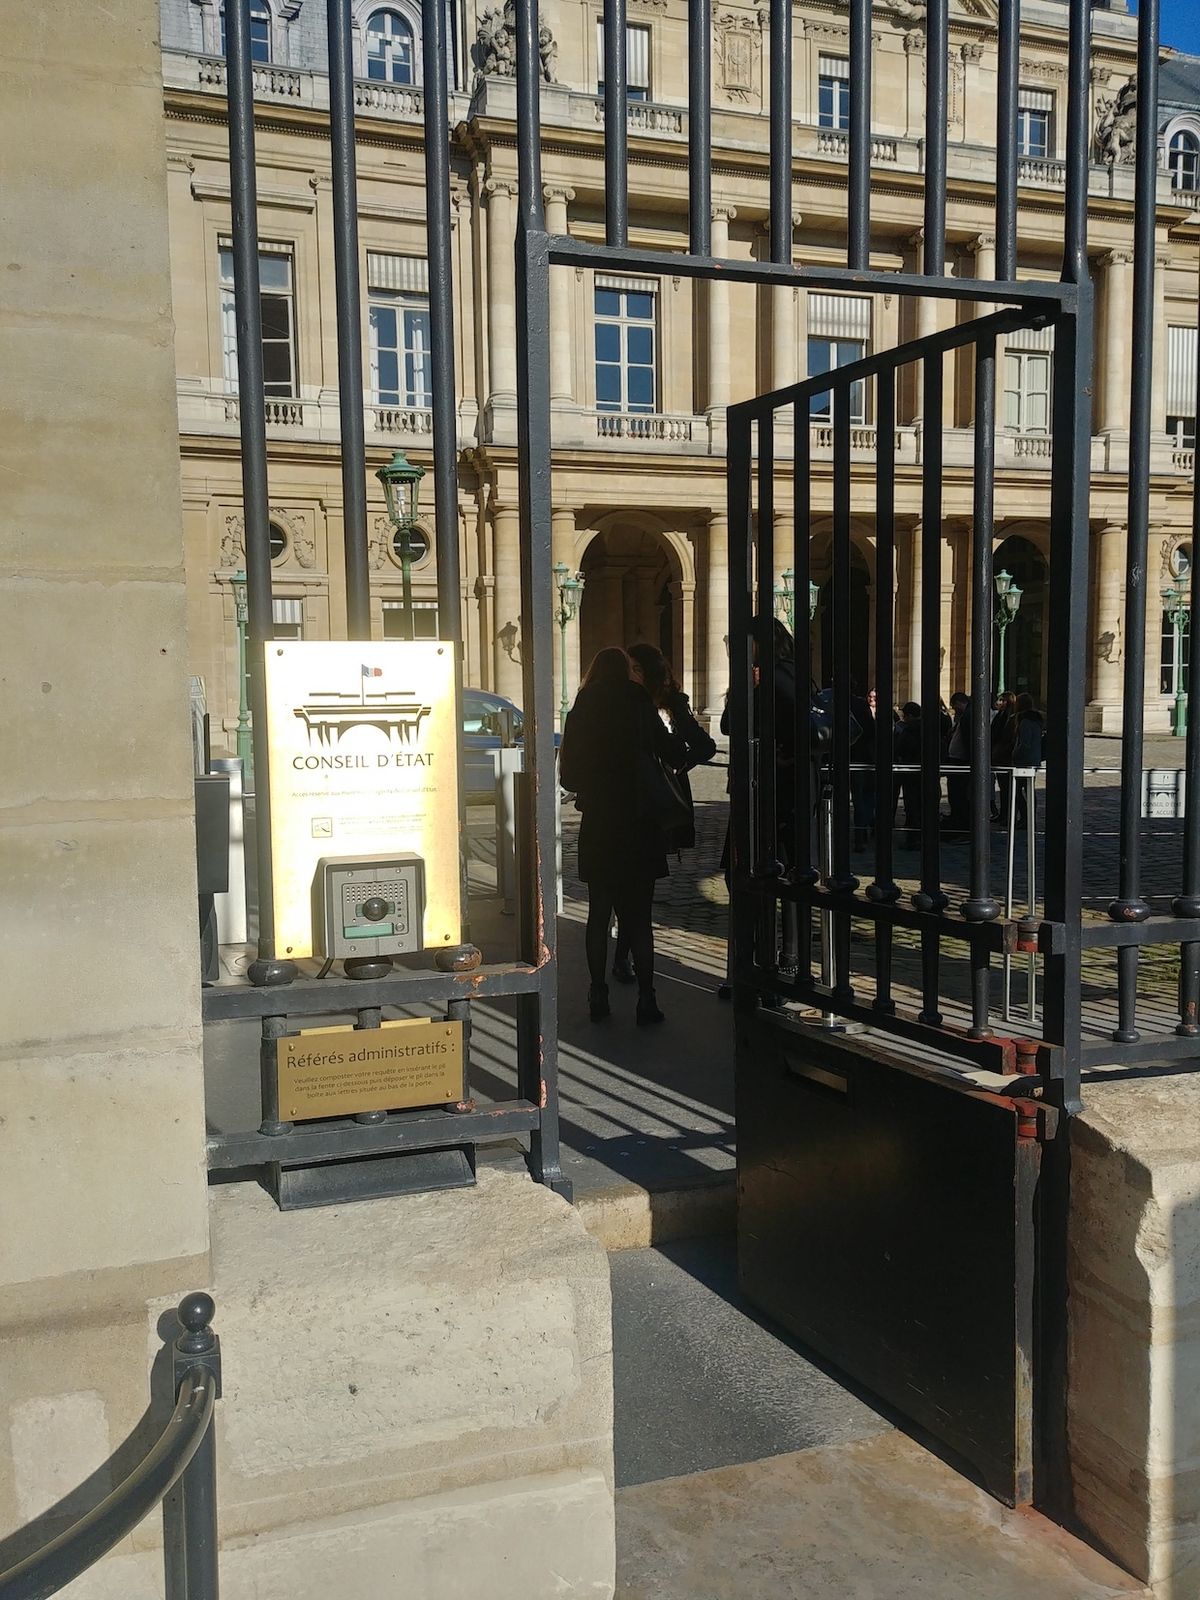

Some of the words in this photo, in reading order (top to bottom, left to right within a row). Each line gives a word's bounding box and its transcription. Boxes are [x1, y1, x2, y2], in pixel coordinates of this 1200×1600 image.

[293, 755, 369, 770] CONSEIL
[377, 751, 434, 767] D'ÉTAT
[287, 1050, 344, 1069] Référés
[348, 1041, 447, 1063] administratifs
[294, 1076, 318, 1084] Veuillez
[320, 1073, 353, 1082] composter
[372, 1068, 396, 1077] requête
[406, 1064, 431, 1072] insérant
[369, 1078, 382, 1086] puis
[383, 1075, 408, 1083] déposer
[360, 1085, 377, 1093] située
